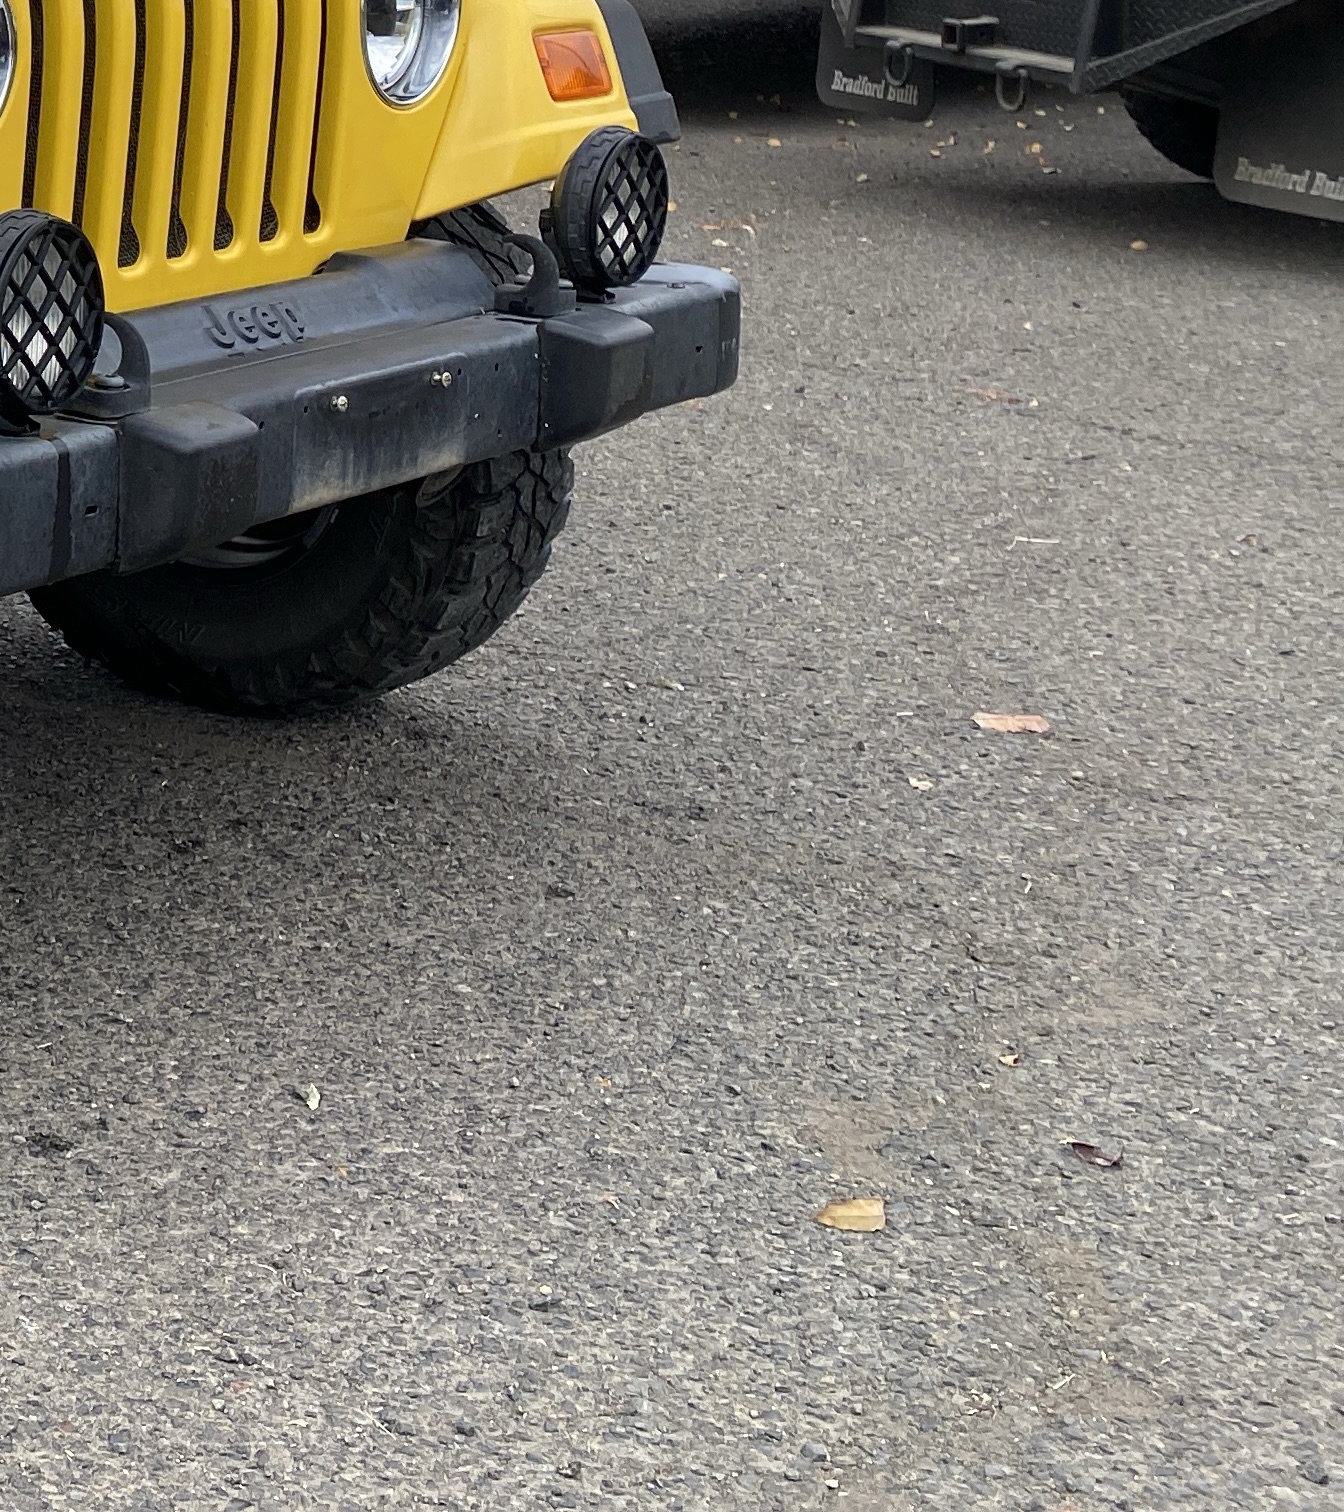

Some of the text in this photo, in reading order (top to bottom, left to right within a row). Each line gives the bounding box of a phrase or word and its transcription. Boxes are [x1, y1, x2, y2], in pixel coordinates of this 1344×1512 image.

[831, 69, 886, 100] Bradford
[1232, 156, 1311, 193] Bradford
[203, 301, 306, 350] Jeep
